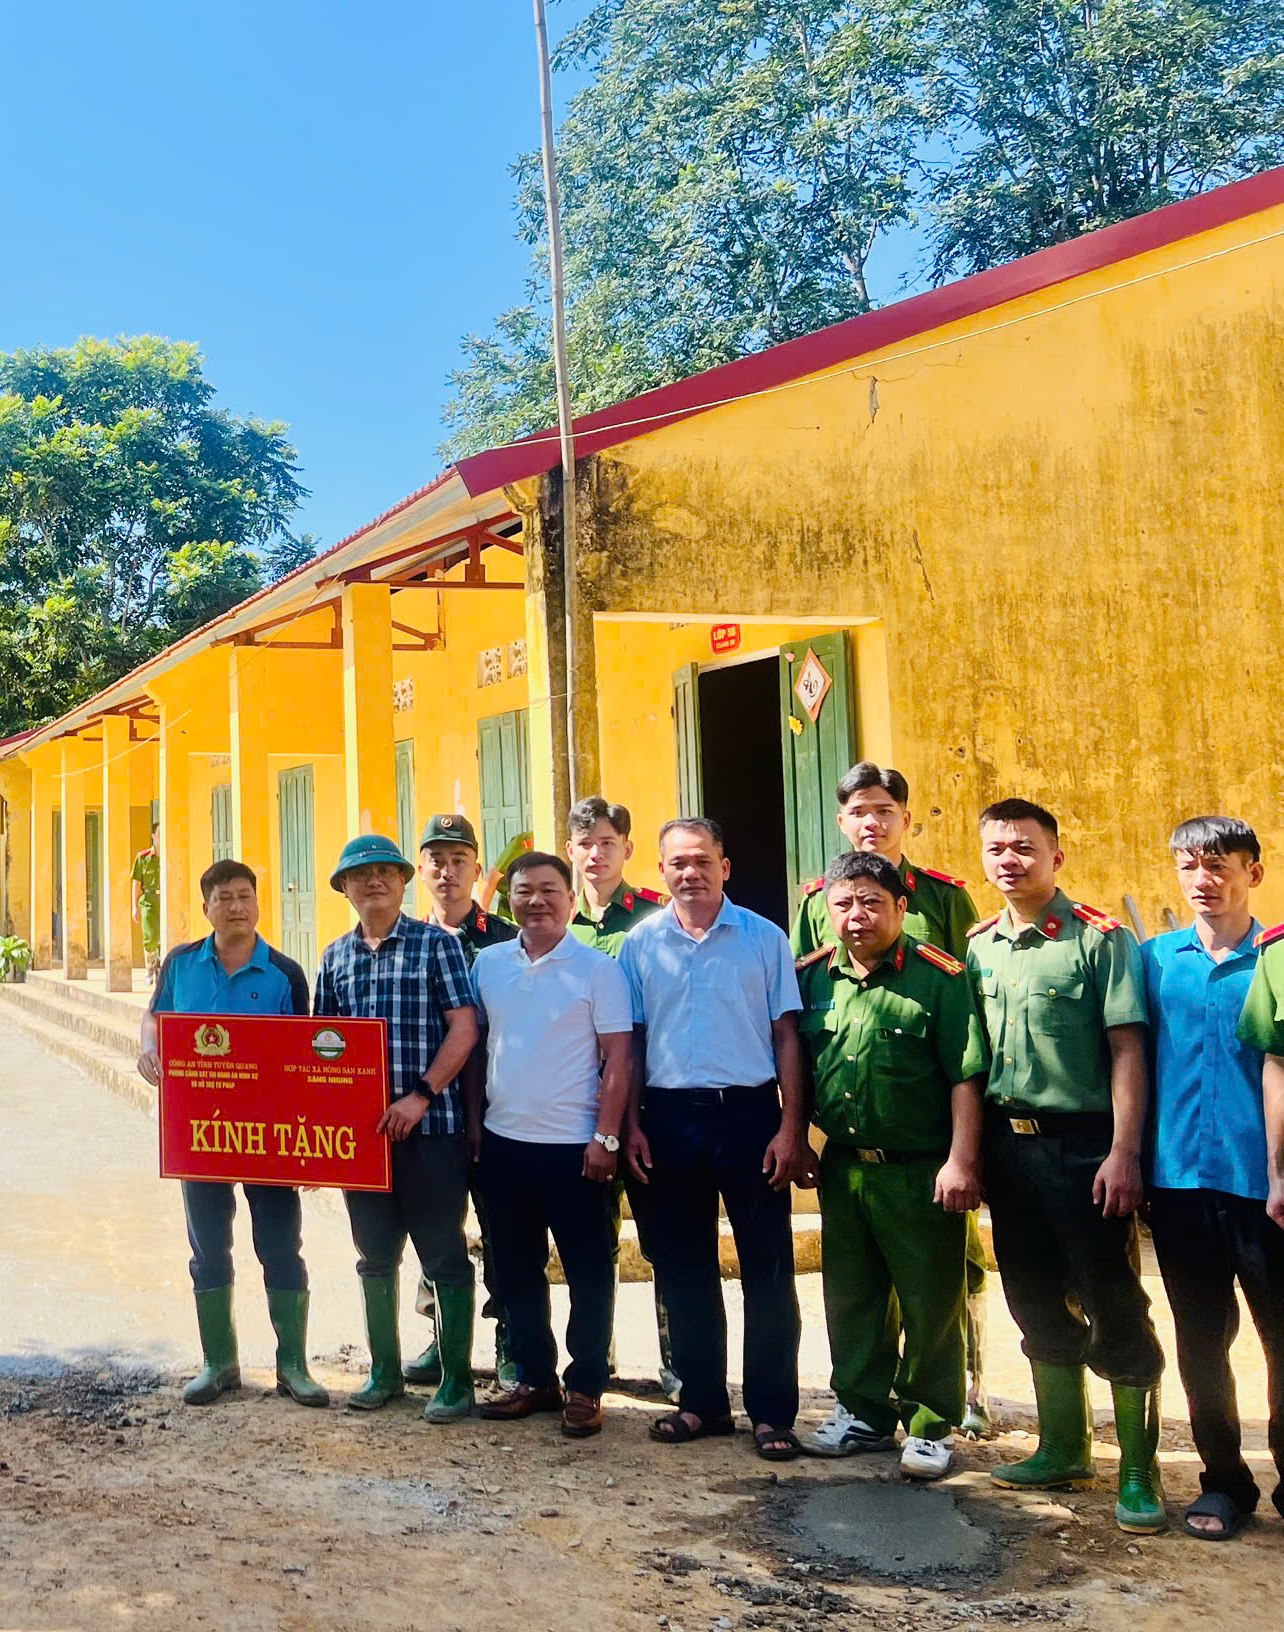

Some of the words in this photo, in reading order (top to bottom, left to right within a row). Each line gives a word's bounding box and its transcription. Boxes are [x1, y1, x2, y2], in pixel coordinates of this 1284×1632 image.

[168, 1058, 186, 1068] CÔNG
[186, 1060, 196, 1068] AN
[197, 1059, 213, 1069] TỈNH
[213, 1060, 235, 1070] TUYÊN
[235, 1062, 258, 1070] QUANG
[322, 1064, 341, 1074] NÔNG
[356, 1067, 376, 1075] XANH
[328, 1076, 354, 1085] NHUNG
[190, 1109, 267, 1155] KÍNH
[273, 1114, 357, 1167] TẶNG
